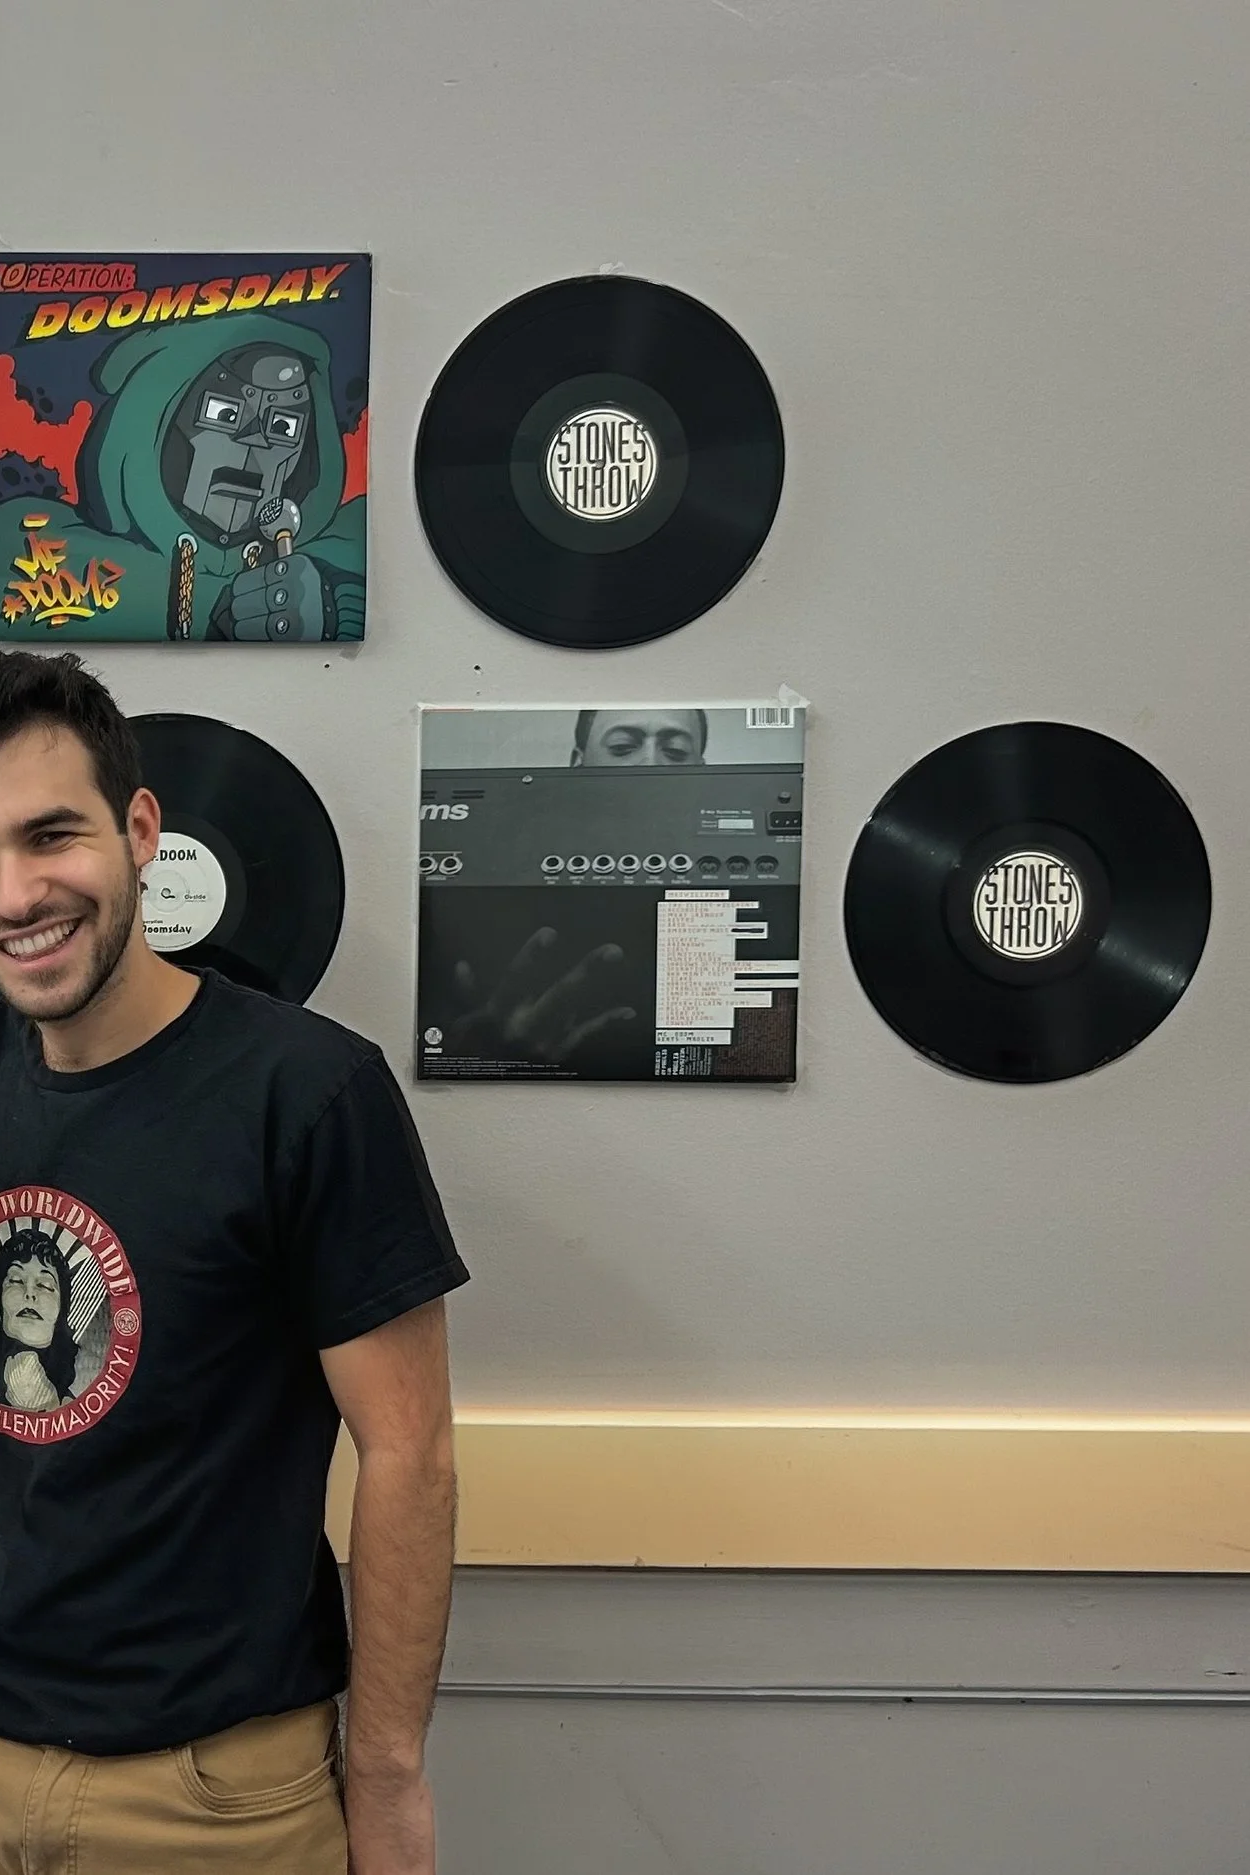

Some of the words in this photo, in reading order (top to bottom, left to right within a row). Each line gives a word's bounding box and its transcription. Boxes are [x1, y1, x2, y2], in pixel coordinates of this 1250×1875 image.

[2, 264, 134, 289] OPERATION:
[557, 421, 646, 465] STONES
[557, 465, 644, 510] THROW
[984, 863, 1073, 906] STONES
[985, 906, 1070, 948] THROW
[49, 1344, 135, 1438] MAJORITY!
